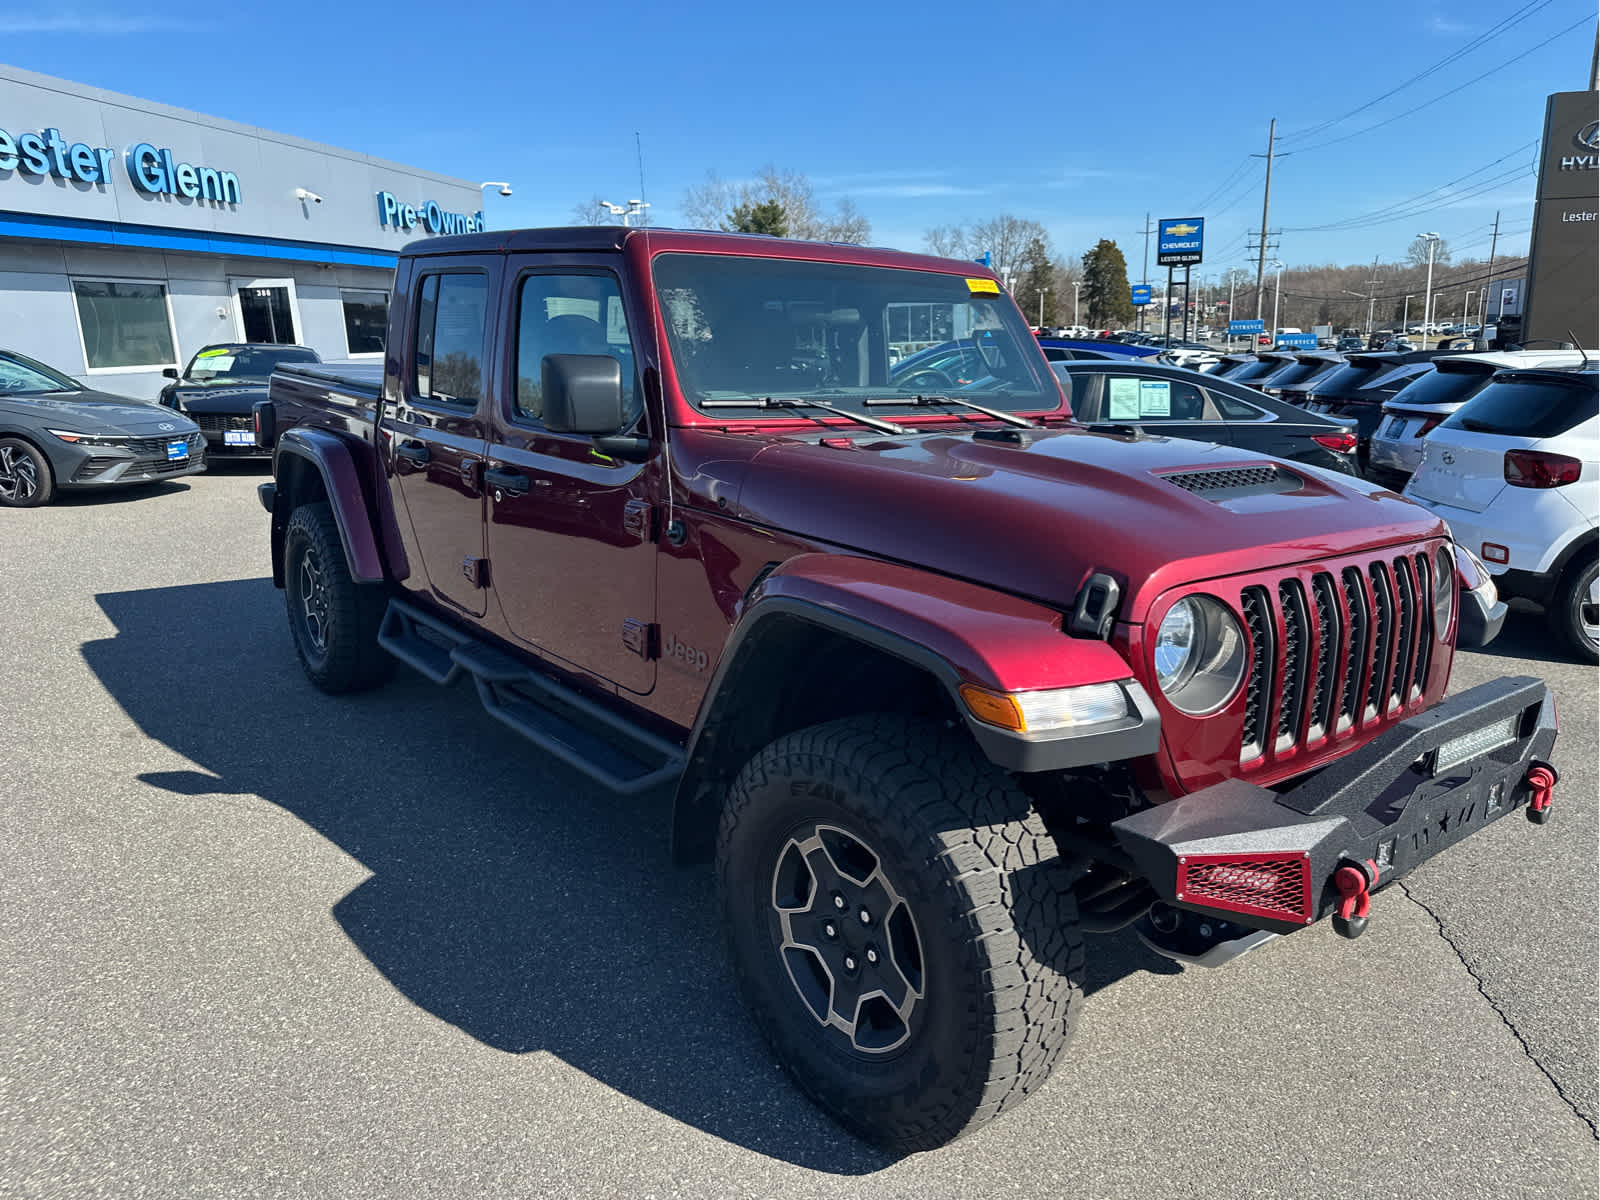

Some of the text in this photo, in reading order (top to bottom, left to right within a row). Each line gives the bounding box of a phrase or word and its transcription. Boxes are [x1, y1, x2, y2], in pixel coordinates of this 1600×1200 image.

[125, 143, 241, 204] Glenn
[377, 191, 485, 235] Pre-Owned
[1562, 211, 1598, 222] Lester
[1161, 241, 1201, 250] CHEVROLET
[1160, 254, 1200, 263] LESTER GLENN
[662, 632, 708, 672] Jeep
